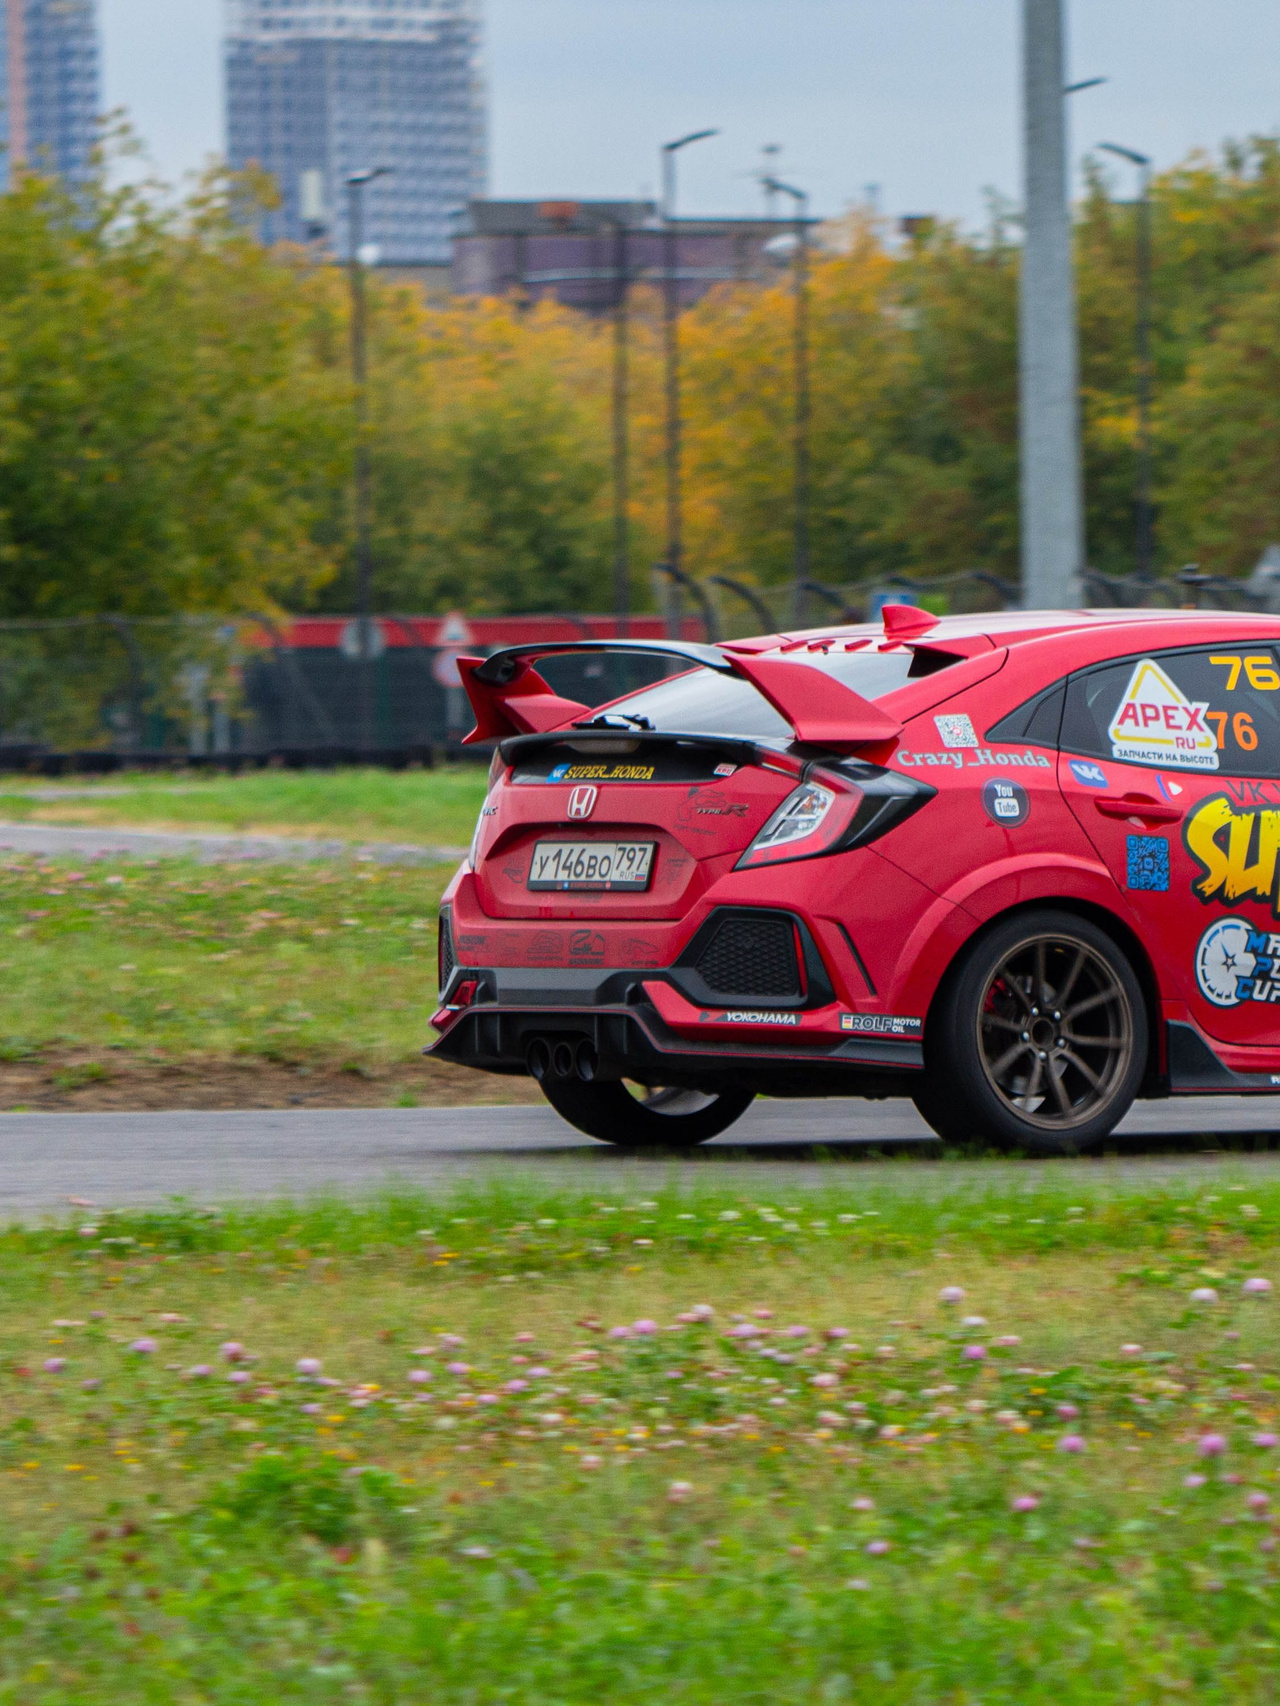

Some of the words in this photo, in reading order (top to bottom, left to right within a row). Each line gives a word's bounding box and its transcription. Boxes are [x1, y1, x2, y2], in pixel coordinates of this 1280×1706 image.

[1208, 656, 1280, 691] 76
[1117, 702, 1206, 733] APEX
[1205, 711, 1258, 751] 76
[1175, 736, 1196, 750] RU
[896, 749, 1051, 769] Crazy_Honda
[1117, 749, 1163, 762] ЗАПЧАСТИ
[1165, 752, 1179, 762] НА
[1179, 753, 1215, 766] ВЫСОТЕ
[564, 765, 655, 780] SUPER_HONDA
[994, 784, 1014, 798] You
[1225, 780, 1270, 803] VK
[997, 800, 1018, 814] Tube
[615, 847, 648, 872] 797
[620, 872, 635, 880] RUS
[726, 1012, 797, 1025] YOKOHAMA
[852, 1016, 892, 1032] ROLF
[892, 1017, 922, 1027] MOTOR
[892, 1025, 905, 1034] OIL
